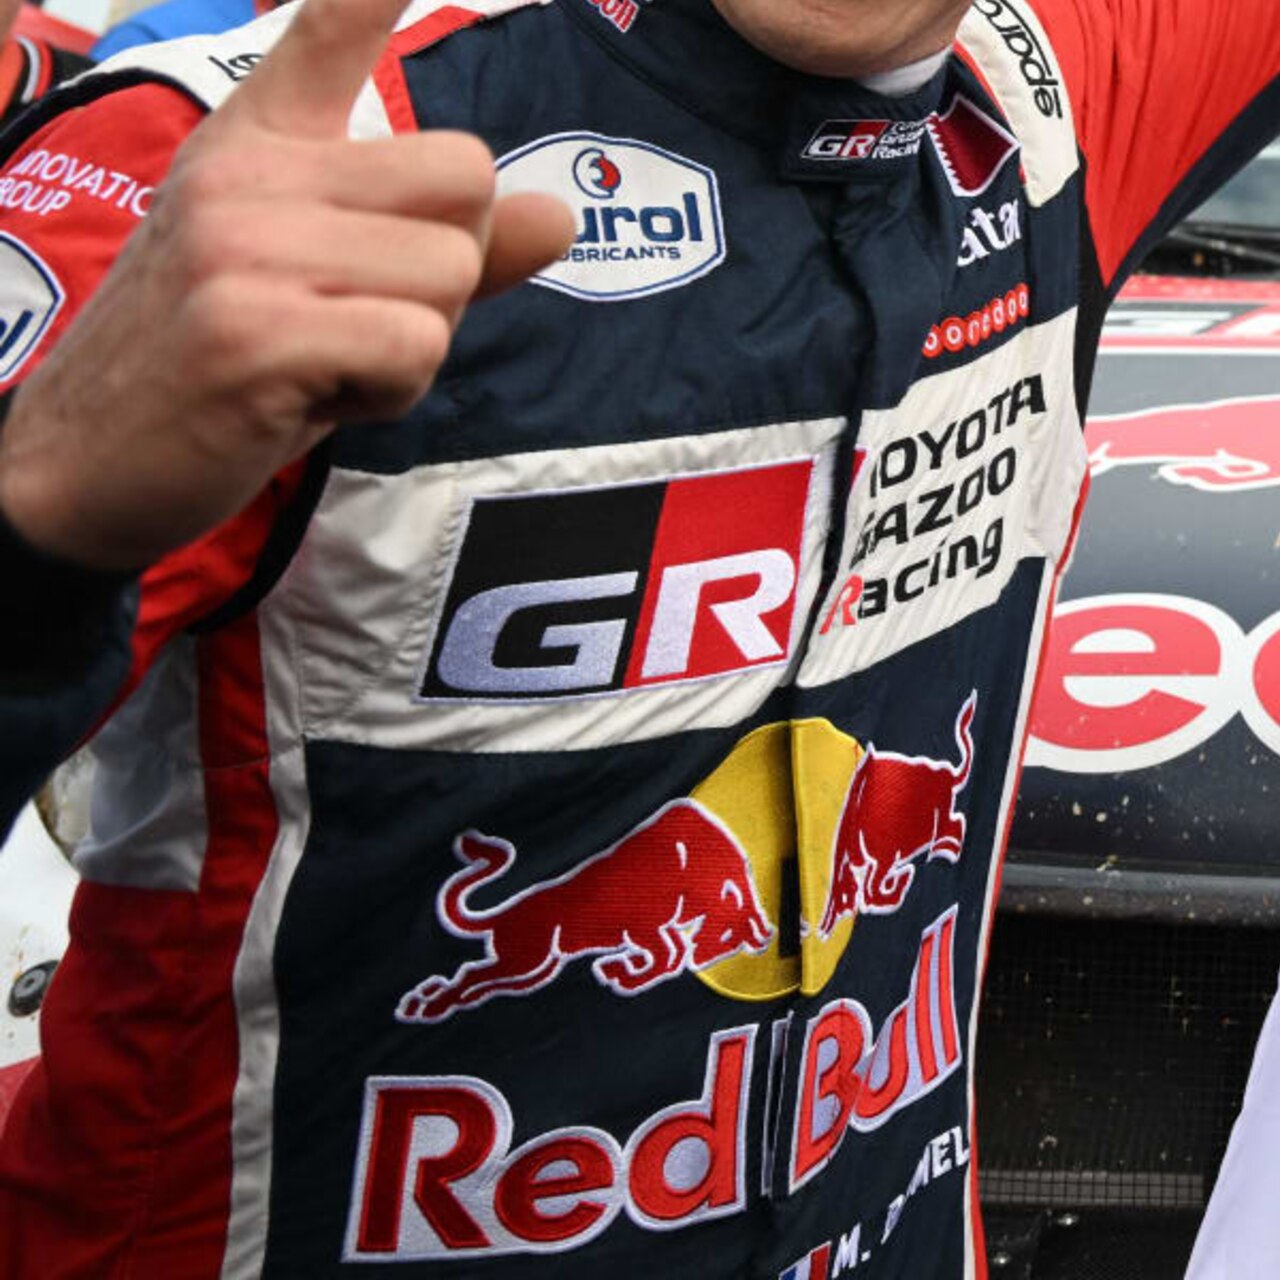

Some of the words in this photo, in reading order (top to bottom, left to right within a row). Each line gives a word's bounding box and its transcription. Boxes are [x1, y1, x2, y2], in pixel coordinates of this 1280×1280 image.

[806, 134, 875, 157] GR
[559, 245, 681, 263] BRICANTS
[574, 191, 703, 244] urol
[819, 517, 1004, 634] Racing
[436, 547, 797, 691] GR
[341, 1023, 758, 1262] Red
[789, 903, 960, 1195] Bull
